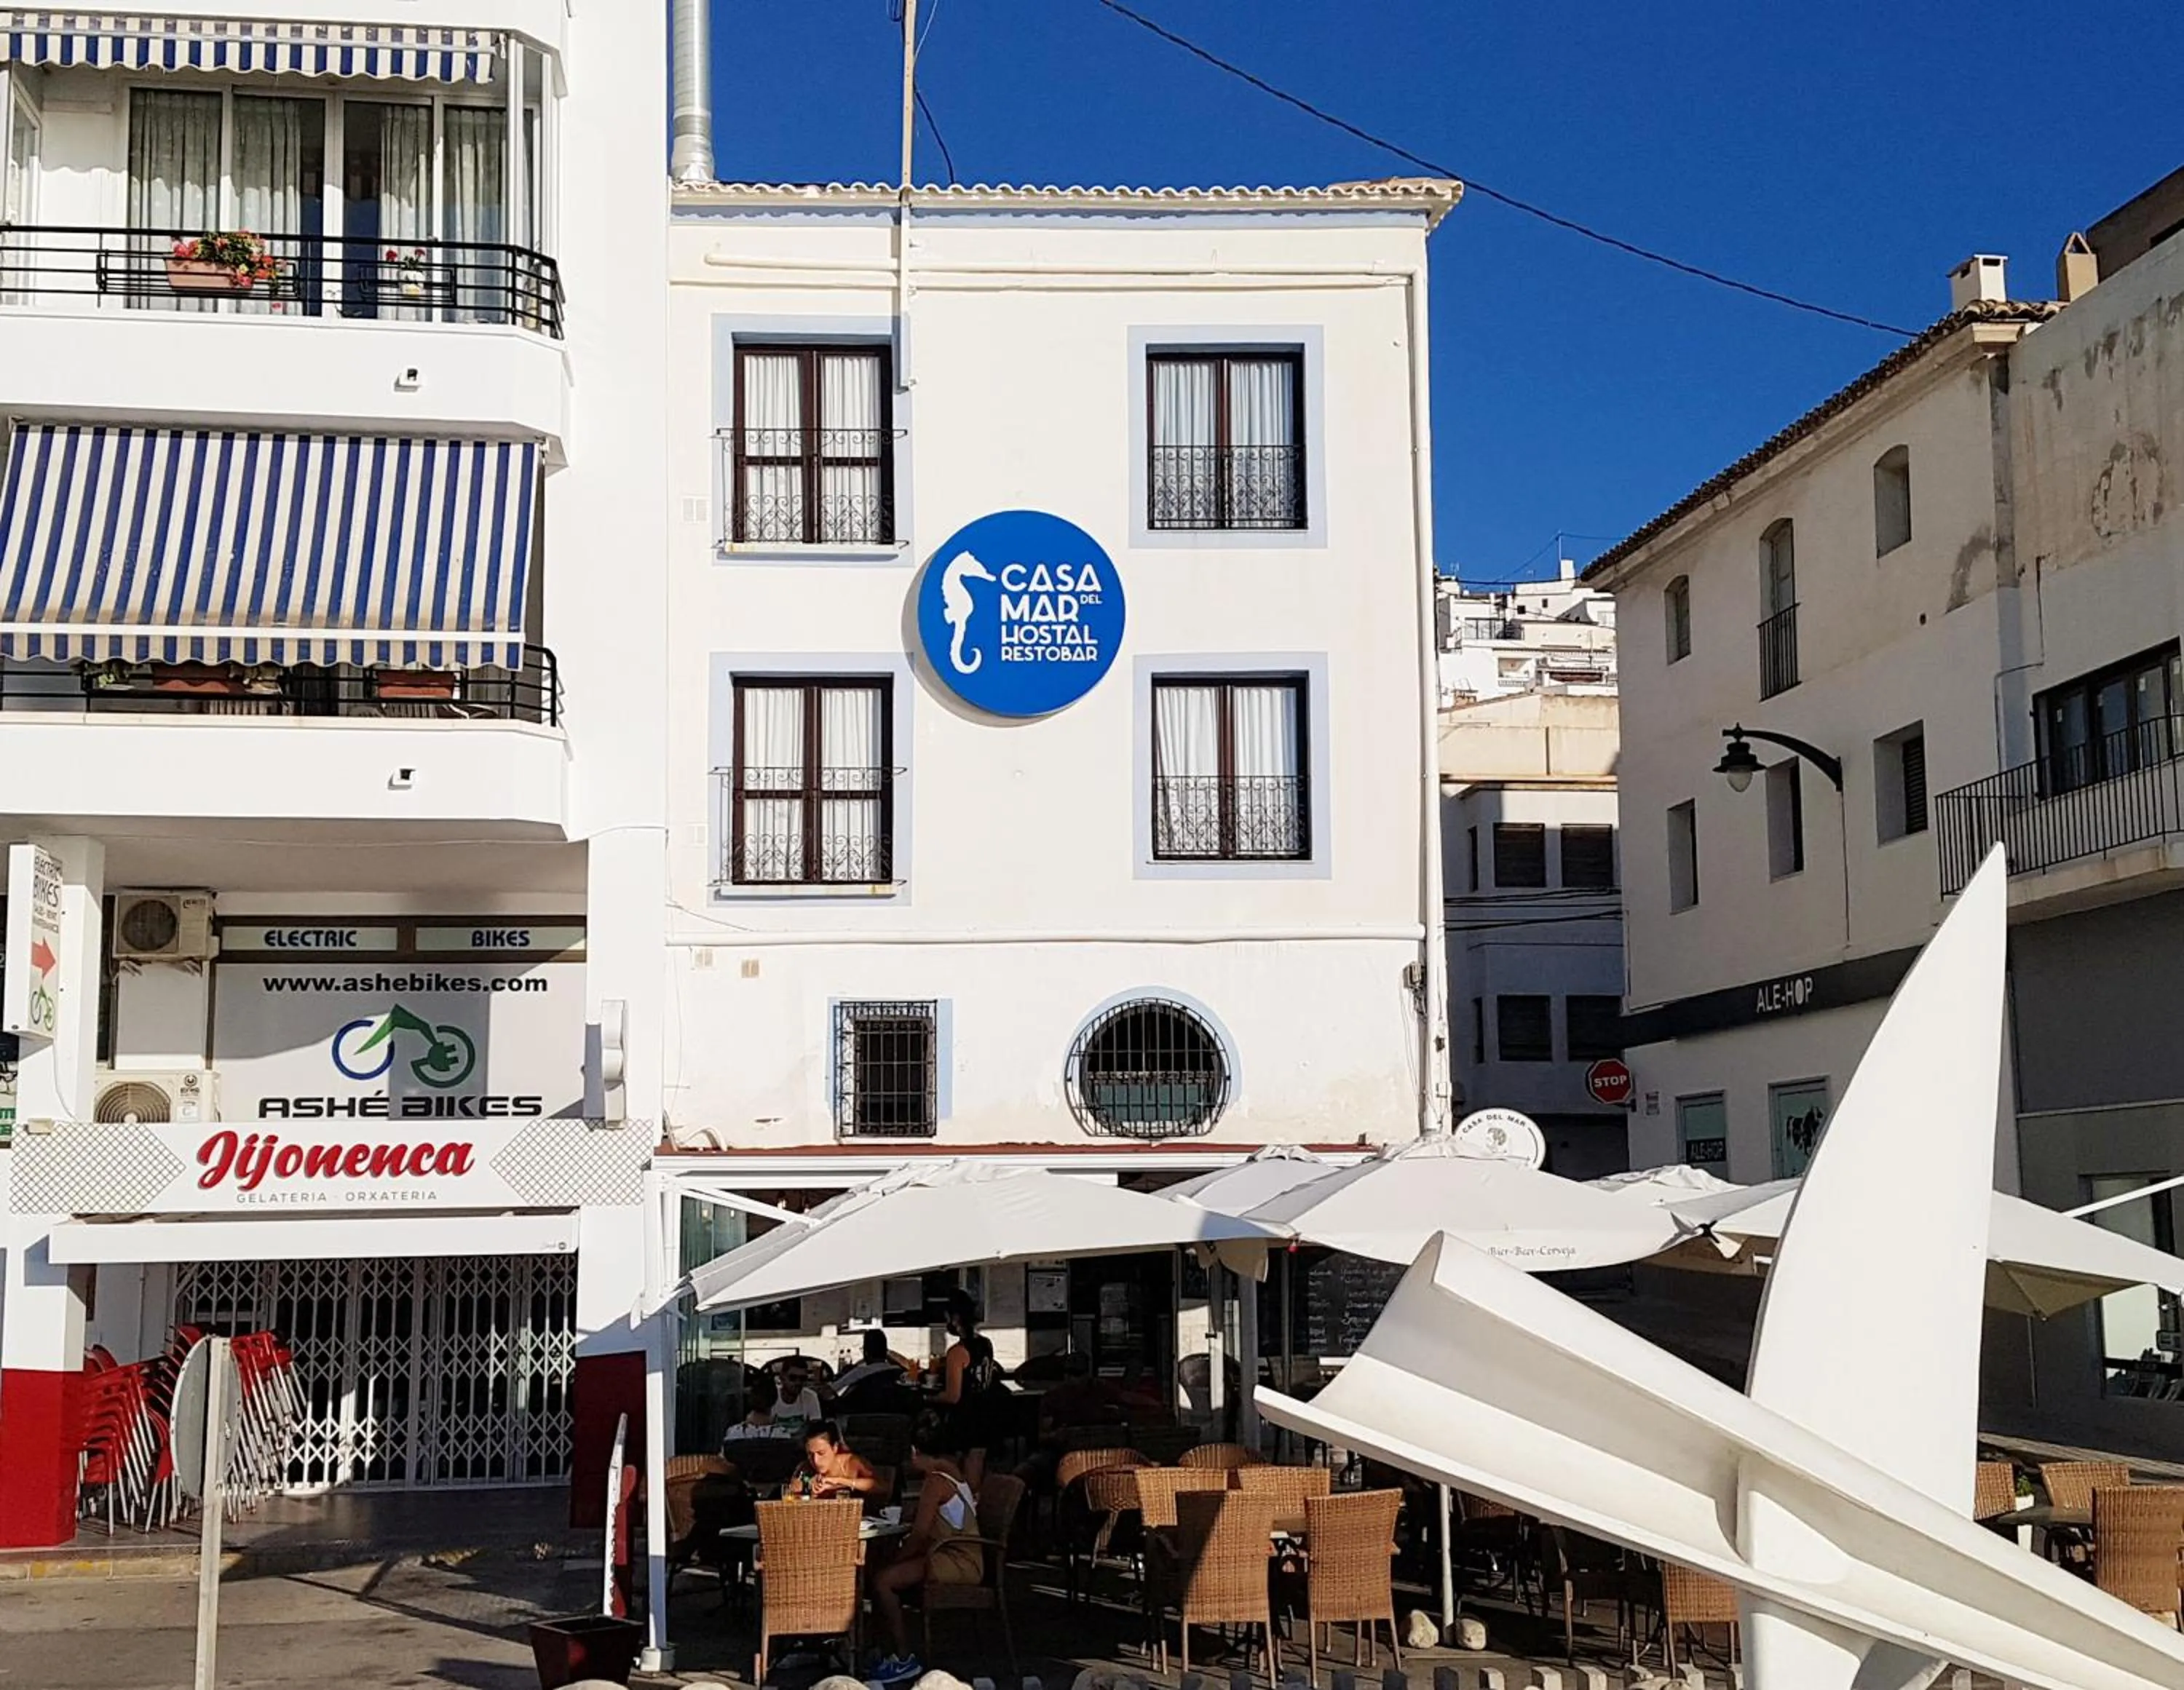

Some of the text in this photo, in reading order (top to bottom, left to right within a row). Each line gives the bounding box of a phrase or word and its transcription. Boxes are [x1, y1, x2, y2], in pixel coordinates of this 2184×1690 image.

[1000, 563, 1102, 592] CASA
[1000, 593, 1080, 623] MAR
[1080, 593, 1102, 605] DEL
[1000, 624, 1098, 645] HOSTAL
[1000, 646, 1098, 662] RESTOBAR
[264, 929, 531, 948] ELECTRIC BIKES
[262, 972, 548, 993] www.ashebikes.com
[1755, 977, 1814, 1014] ALE-HOP
[1594, 1074, 1628, 1089] STOP
[258, 1090, 543, 1119] ASHÉ BIKES
[1462, 1118, 1483, 1134] CASA
[1506, 1114, 1527, 1127] MAR
[196, 1130, 475, 1192] Jijonenca
[237, 1191, 438, 1204] GELATERIA ORXATERIA
